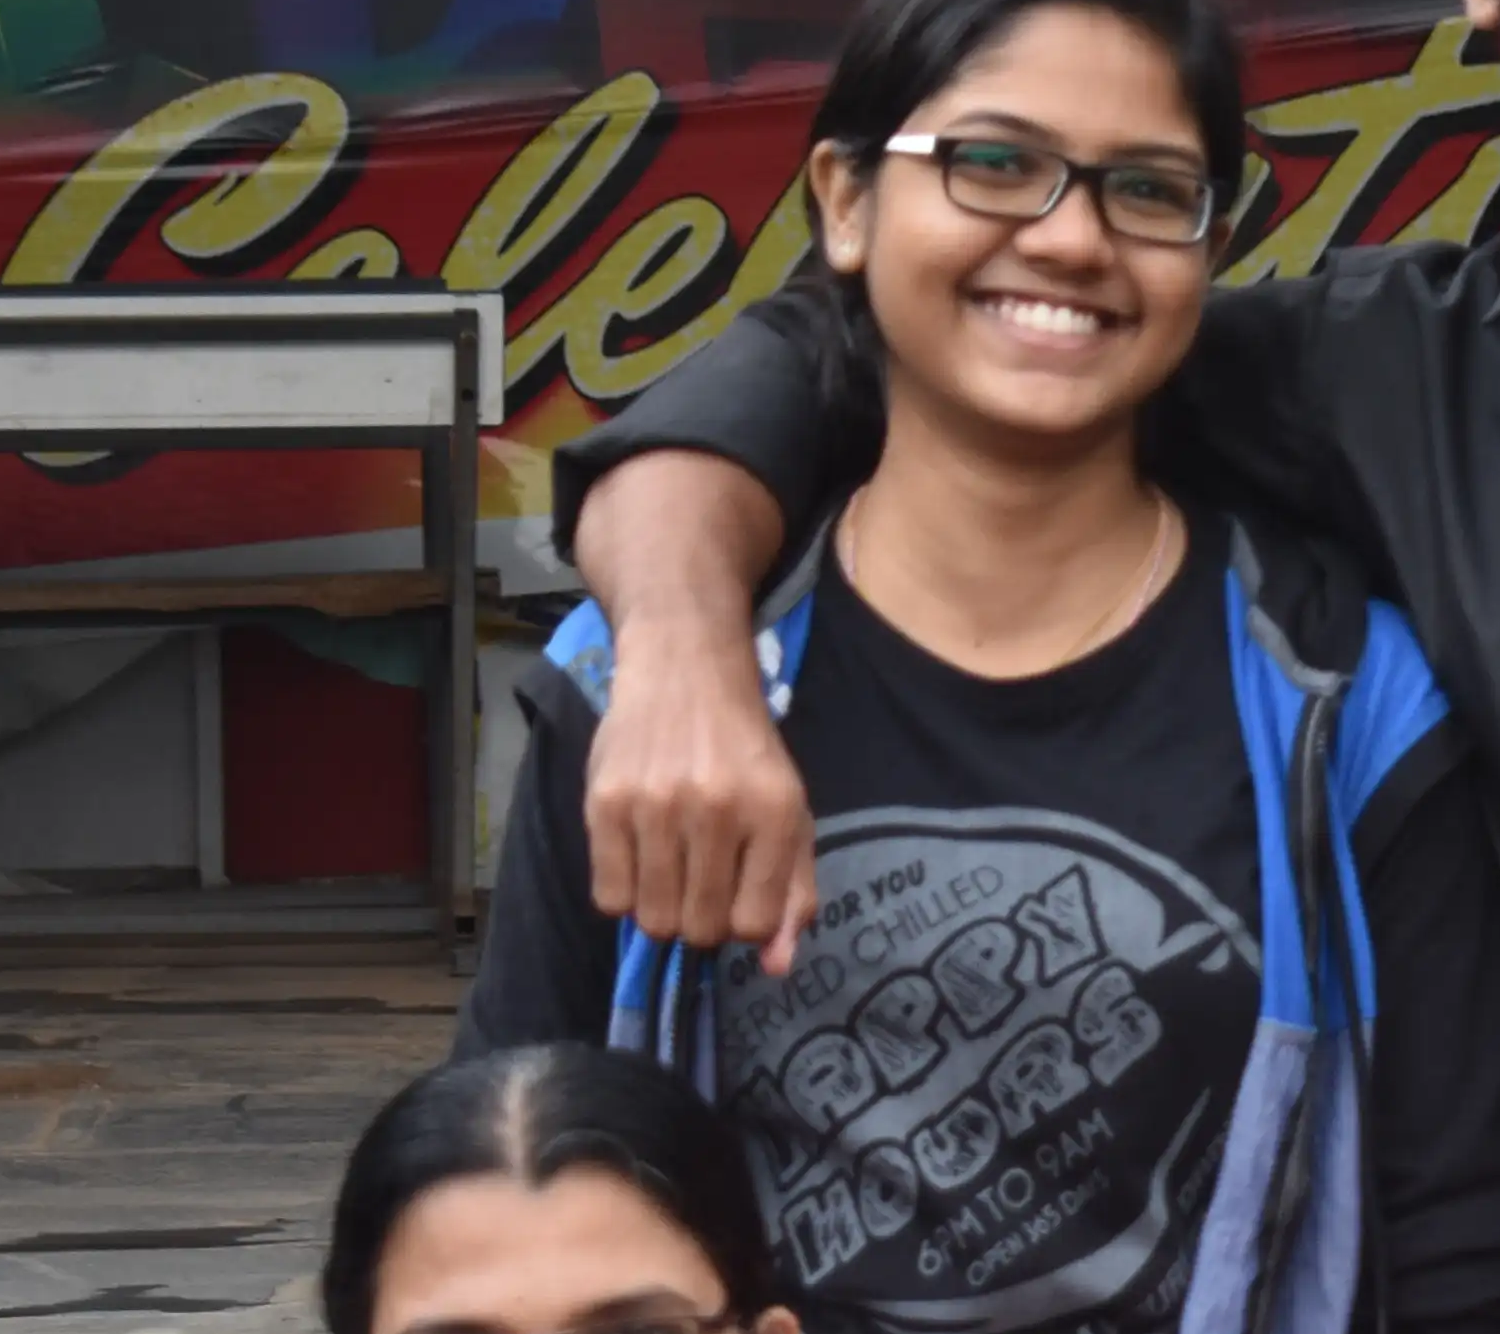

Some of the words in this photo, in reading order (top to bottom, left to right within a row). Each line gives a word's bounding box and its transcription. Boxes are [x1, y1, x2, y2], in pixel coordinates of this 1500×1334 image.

[850, 864, 1005, 967] CHILLED
[866, 858, 926, 904] YOU
[730, 863, 1110, 1193] HAPPY
[778, 959, 1164, 1287] HOURS
[975, 1166, 1035, 1223] TO
